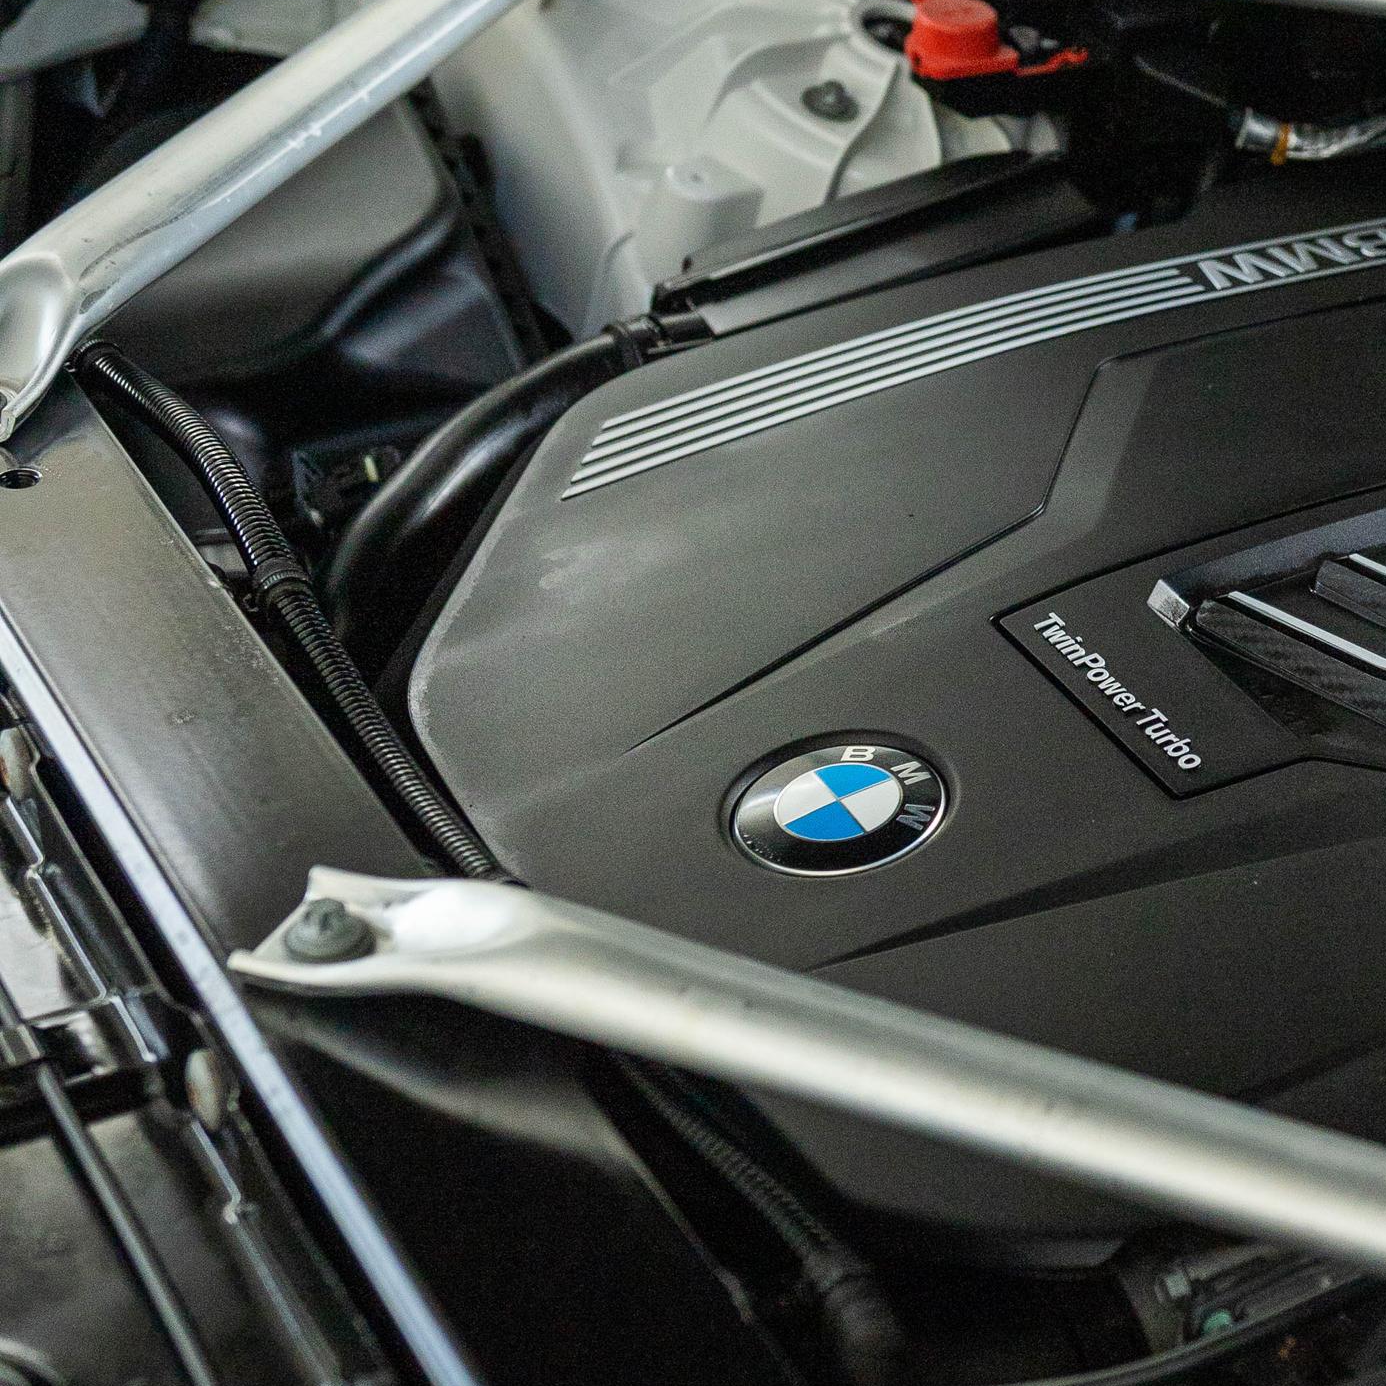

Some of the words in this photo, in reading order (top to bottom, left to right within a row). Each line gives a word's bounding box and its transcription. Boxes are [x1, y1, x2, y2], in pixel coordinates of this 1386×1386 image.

[1034, 612, 1146, 712] TwinPower
[1136, 708, 1201, 769] Turbo
[840, 745, 936, 831] BMW
